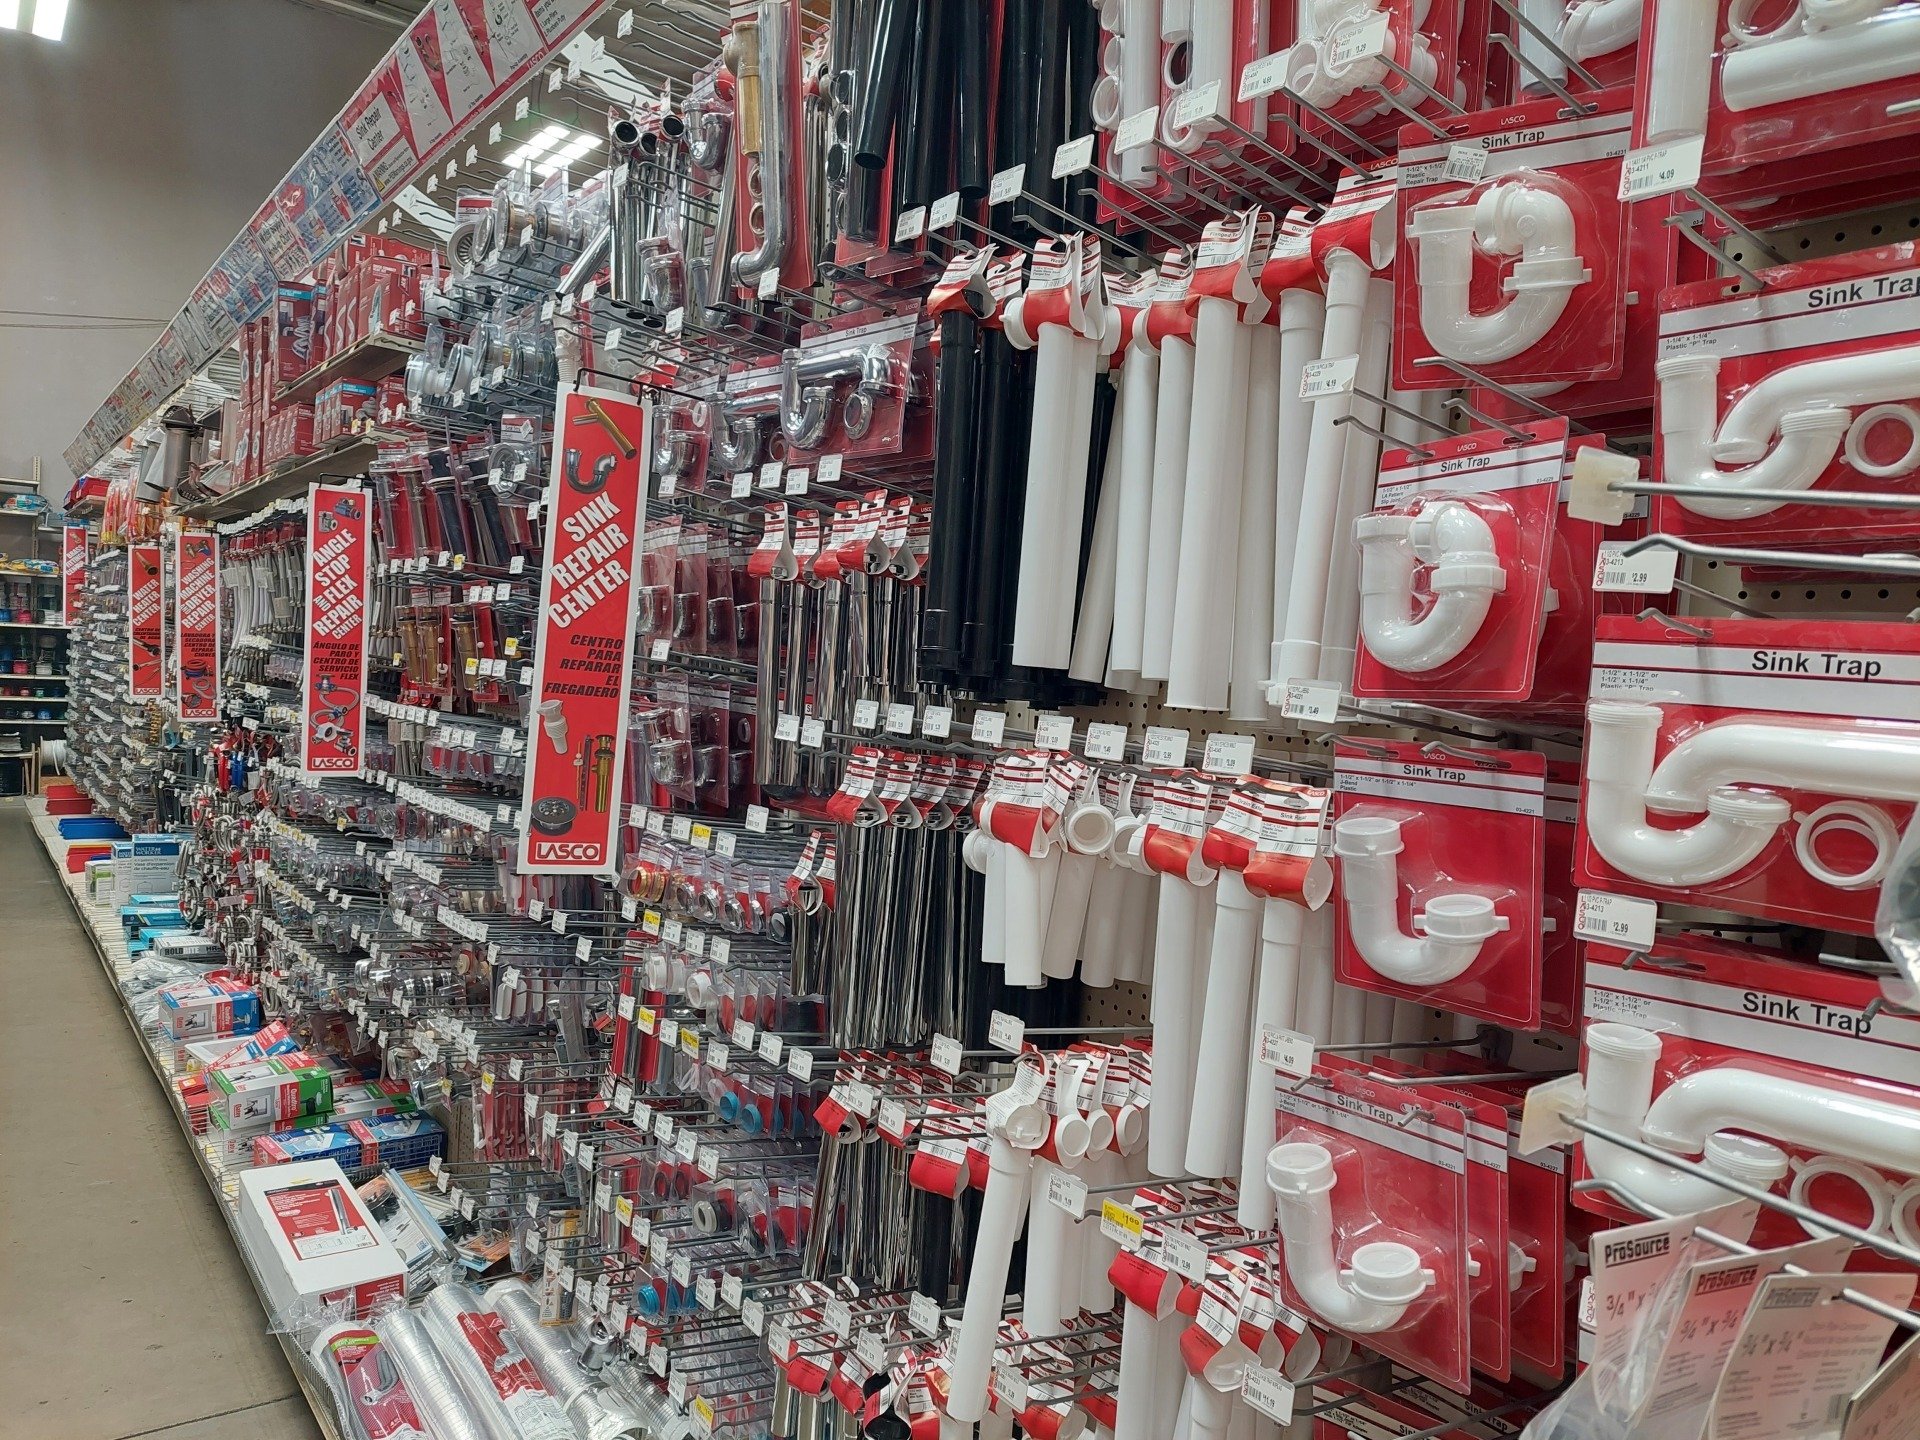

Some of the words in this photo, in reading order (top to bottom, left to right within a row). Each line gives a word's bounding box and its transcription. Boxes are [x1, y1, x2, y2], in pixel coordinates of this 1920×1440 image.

[1501, 114, 1526, 125] LASCO
[1481, 135, 1511, 150] Sink
[1514, 129, 1545, 144] Trap
[1606, 149, 1627, 157] 03-4231
[1370, 158, 1398, 170] LASCO
[1405, 178, 1424, 186] Repair
[1406, 172, 1426, 180] Plastic
[1355, 188, 1381, 198] Extension
[1807, 285, 1863, 308] Sink
[1457, 442, 1477, 452] LASCO
[1440, 459, 1463, 473] Sink
[1466, 455, 1490, 469] Trap
[562, 490, 621, 542] SINK
[312, 528, 357, 567] ANGLE
[549, 523, 630, 590] REPAIR
[181, 557, 215, 585] WASHING
[314, 553, 351, 587] STOP
[1632, 572, 1648, 583] $2.99
[132, 579, 160, 600] WATER
[180, 570, 215, 600] MACHINE
[313, 594, 331, 612] AND
[323, 574, 358, 604] FLEX
[548, 559, 630, 628] CENTER
[132, 590, 161, 614] HEATER
[186, 584, 216, 610] DRYER
[132, 602, 161, 627] CENTER
[181, 600, 216, 629] REPAIR
[194, 613, 216, 632] CENTER
[312, 594, 363, 637] REPAIR
[331, 613, 362, 640] CENTER
[313, 640, 347, 650] ÁNGULO
[570, 634, 624, 649] CENTRO
[313, 657, 347, 665] CENTRO
[329, 650, 353, 658] PARO
[586, 648, 622, 662] PARA
[318, 664, 359, 672] SERVICIO
[559, 658, 621, 673] REPARAR
[1751, 650, 1809, 673] Sink
[1820, 653, 1882, 682] Trap
[339, 672, 360, 680] FLEX
[605, 675, 619, 687] EL
[544, 682, 619, 698] FREGADERO
[185, 709, 215, 717] LASCO
[312, 757, 354, 769] LASCO
[1403, 764, 1432, 777] Sink
[1436, 767, 1466, 782] Trap
[536, 843, 600, 861] LASCO
[1613, 921, 1629, 933] $2.99
[1593, 990, 1613, 998] 1-1/2"
[1621, 995, 1641, 1004] 1-1/2"
[1593, 996, 1613, 1005] 1-1/2"
[1621, 1002, 1641, 1010] 1-1/4"
[1632, 1010, 1647, 1019] Trap
[1742, 991, 1800, 1021] Sink
[1810, 1003, 1872, 1038] Trap
[1337, 1094, 1364, 1112] Sink
[1367, 1104, 1394, 1123] Trap
[1604, 1234, 1670, 1265] ProSource
[1697, 1266, 1758, 1293] ProSource
